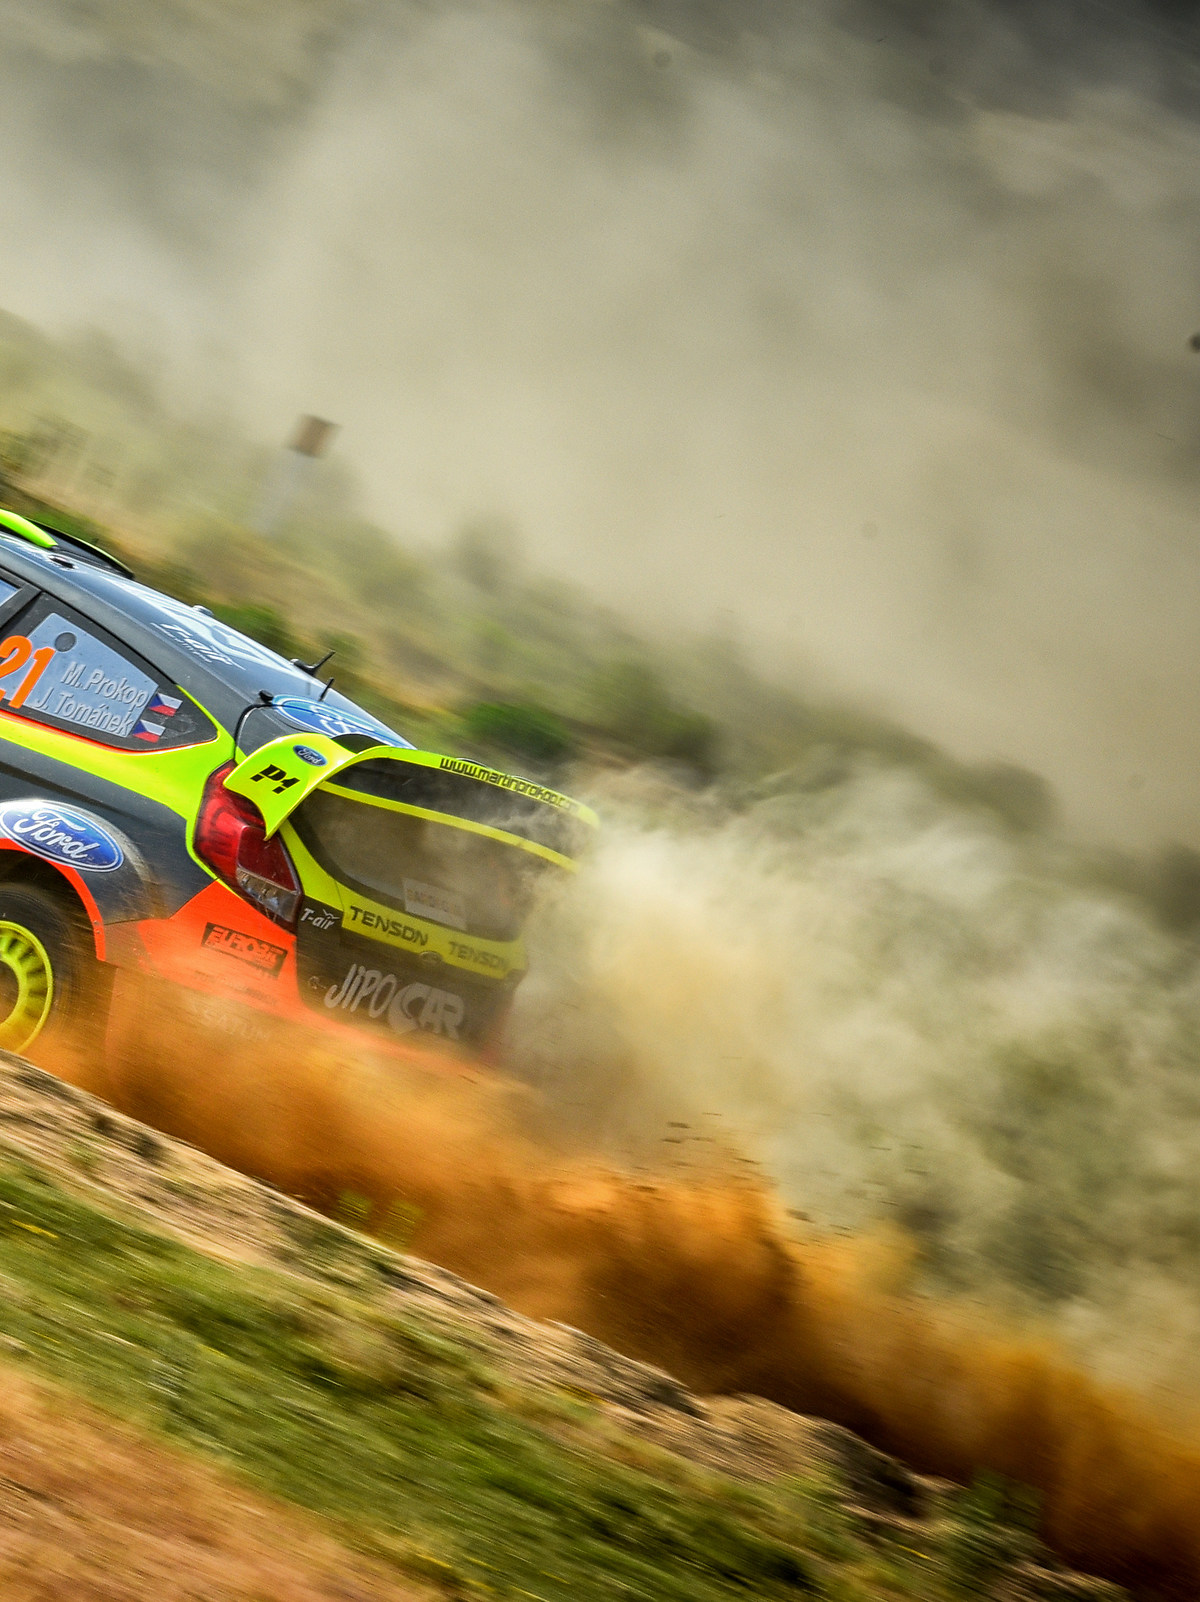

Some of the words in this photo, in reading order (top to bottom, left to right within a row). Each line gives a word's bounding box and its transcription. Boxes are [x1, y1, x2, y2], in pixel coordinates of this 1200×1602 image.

[60, 662, 83, 690] M.
[83, 669, 150, 711] Prokop
[33, 687, 50, 711] J.
[53, 692, 136, 736] Tománek
[297, 747, 323, 765] Ford
[249, 764, 301, 795] P1
[13, 808, 101, 860] Ford
[350, 905, 429, 947] TENSON
